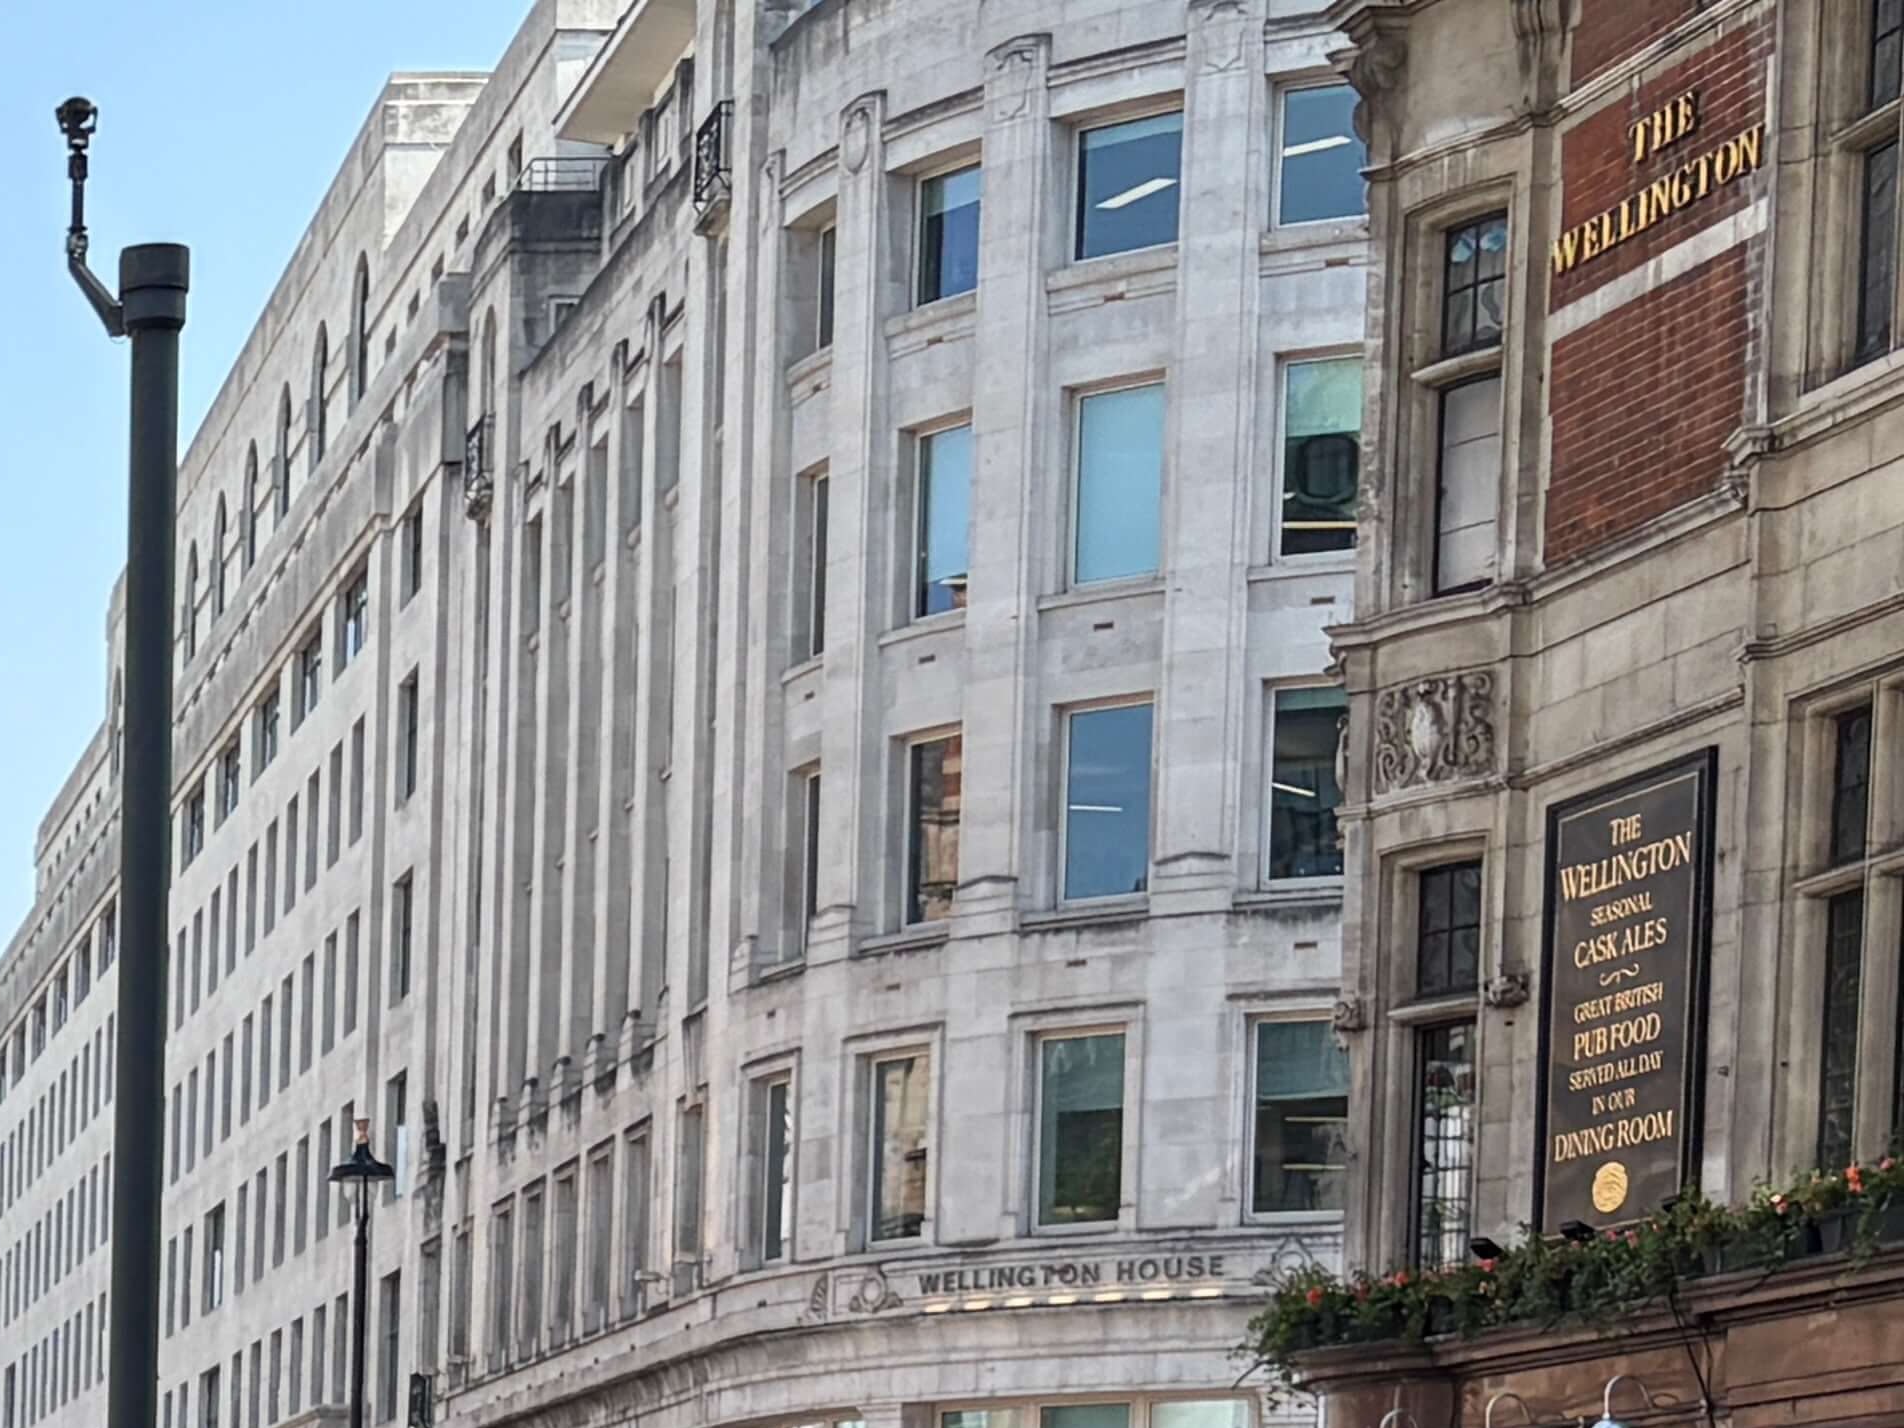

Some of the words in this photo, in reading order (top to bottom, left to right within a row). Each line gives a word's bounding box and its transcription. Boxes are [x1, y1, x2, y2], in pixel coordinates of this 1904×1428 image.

[1629, 91, 1699, 162] THE
[1552, 122, 1765, 273] WELLINGTON
[1610, 813, 1642, 846] THE
[1560, 831, 1692, 902] WELLINGTON
[1590, 891, 1654, 927] SEASONAL
[1574, 931, 1618, 969] CASK
[1622, 917, 1667, 955] ALES
[1574, 996, 1612, 1024] GREAT
[1615, 982, 1664, 1013] BRITISH
[1574, 1027, 1608, 1061] PUB
[1610, 1012, 1662, 1051] FOOD
[1569, 1062, 1615, 1092] SERVED
[1615, 1056, 1638, 1080] ALL
[1638, 1050, 1664, 1073] DAY
[1592, 1094, 1606, 1116] IN
[1607, 1087, 1636, 1112] OUR
[1554, 1123, 1614, 1162] DINING
[1617, 1109, 1673, 1148] ROOM
[918, 1263, 1100, 1294] WELLINGTON
[1116, 1255, 1225, 1282] HOUSE
